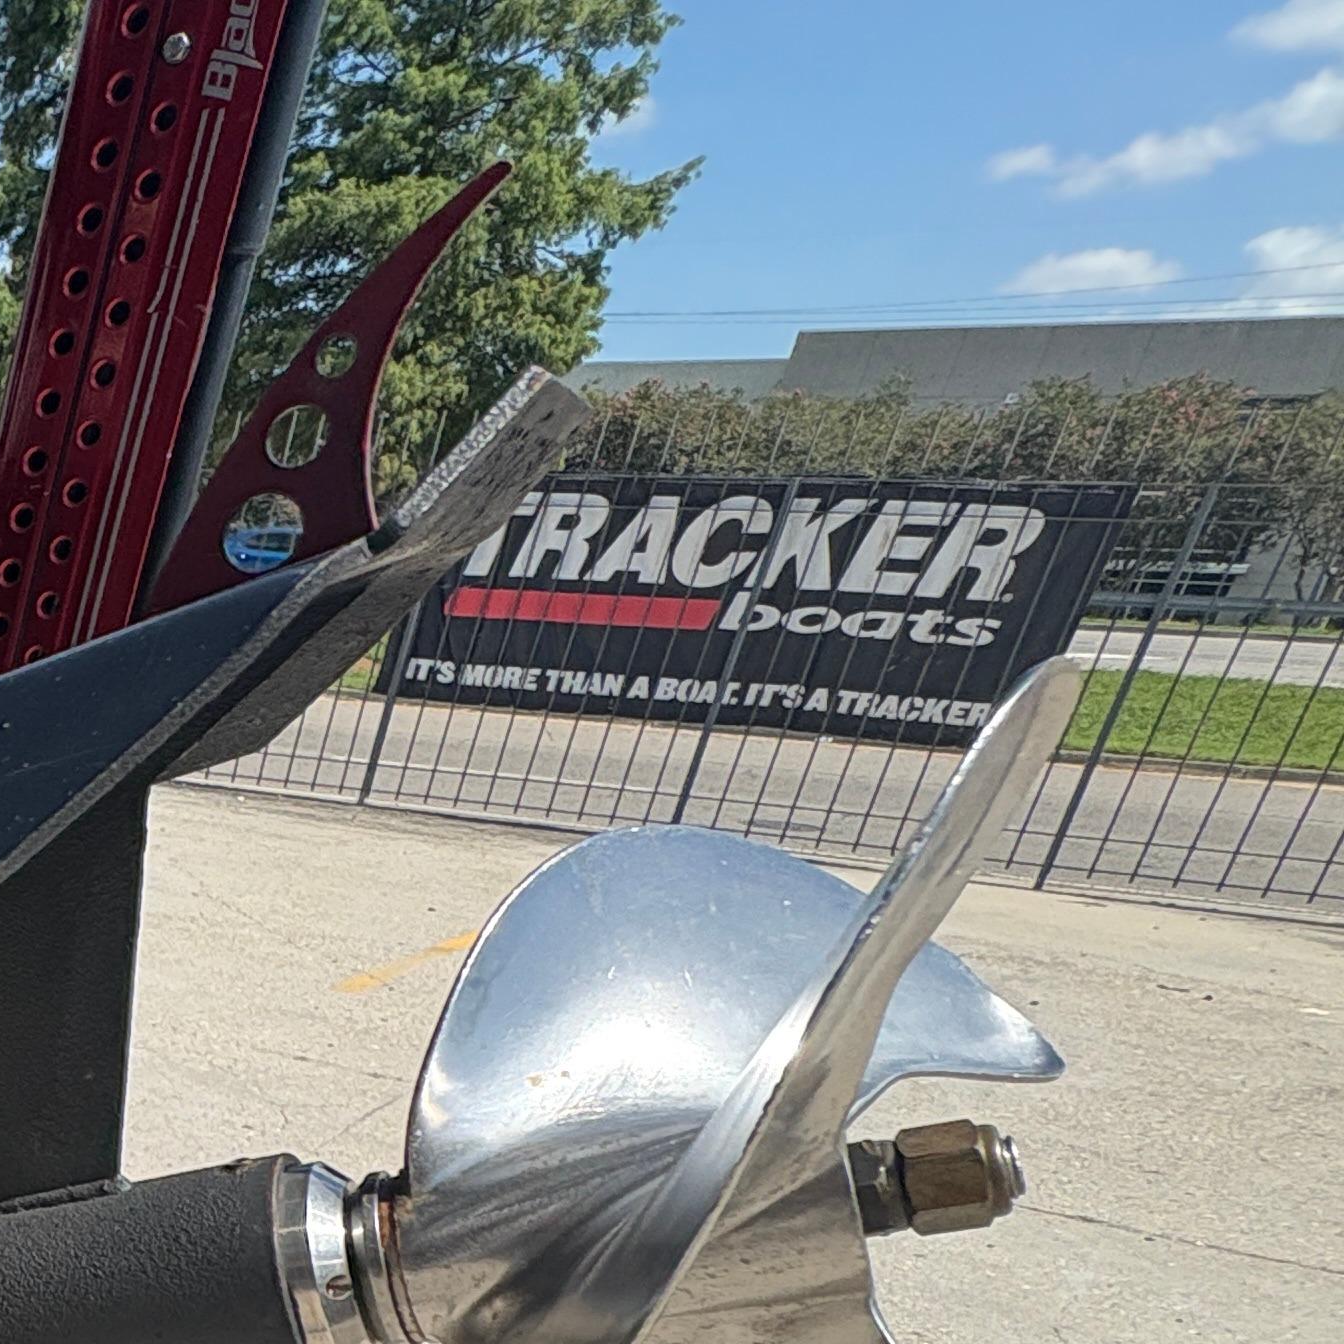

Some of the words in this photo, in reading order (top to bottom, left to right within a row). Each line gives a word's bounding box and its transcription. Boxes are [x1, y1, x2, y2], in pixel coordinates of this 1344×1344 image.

[463, 491, 1045, 602] TRACKER
[718, 591, 1002, 646] boats
[405, 657, 455, 685] IT'S
[461, 664, 543, 691] MORE
[544, 669, 625, 697] THAN
[626, 676, 650, 700] A
[742, 683, 806, 709] IT'S
[803, 688, 829, 713] A
[836, 689, 993, 727] TRACKER
